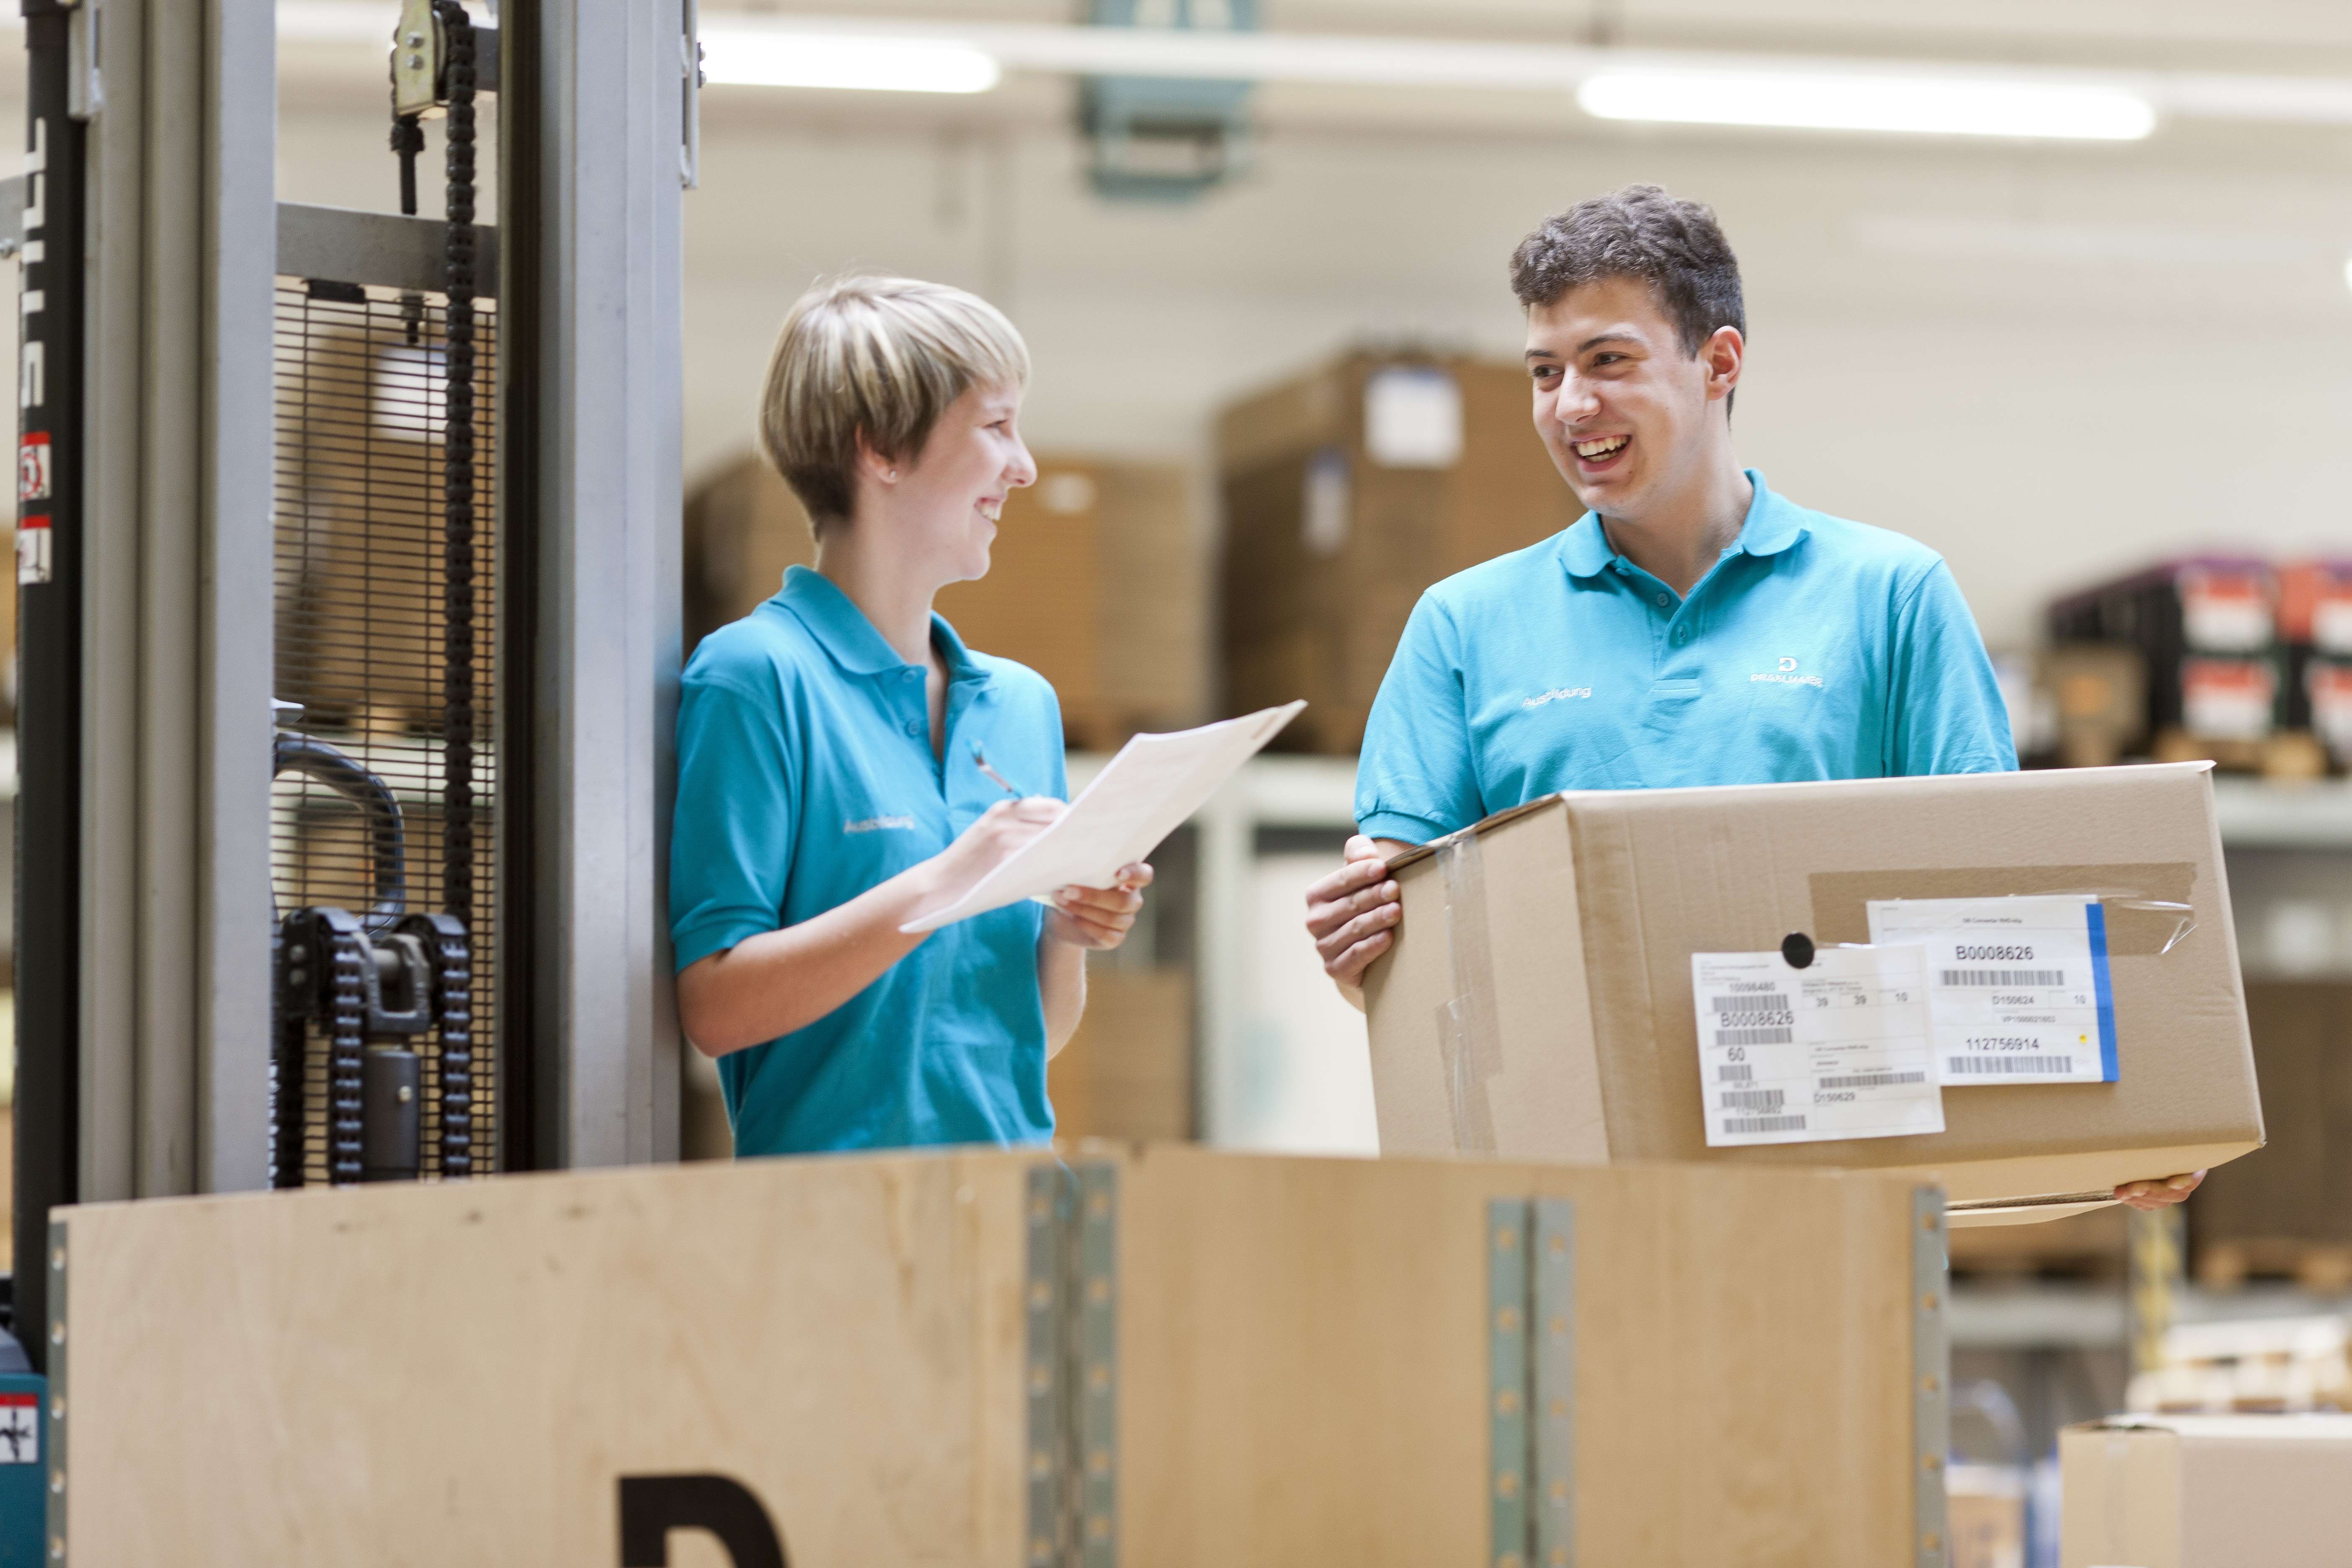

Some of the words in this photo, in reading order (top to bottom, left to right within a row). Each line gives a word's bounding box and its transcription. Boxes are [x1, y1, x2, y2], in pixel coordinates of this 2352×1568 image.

[1955, 946, 2034, 960] B0008626
[1720, 1010, 1794, 1027] B0008626
[1966, 1038, 2040, 1051] 112756914
[1728, 1047, 1746, 1062] 60
